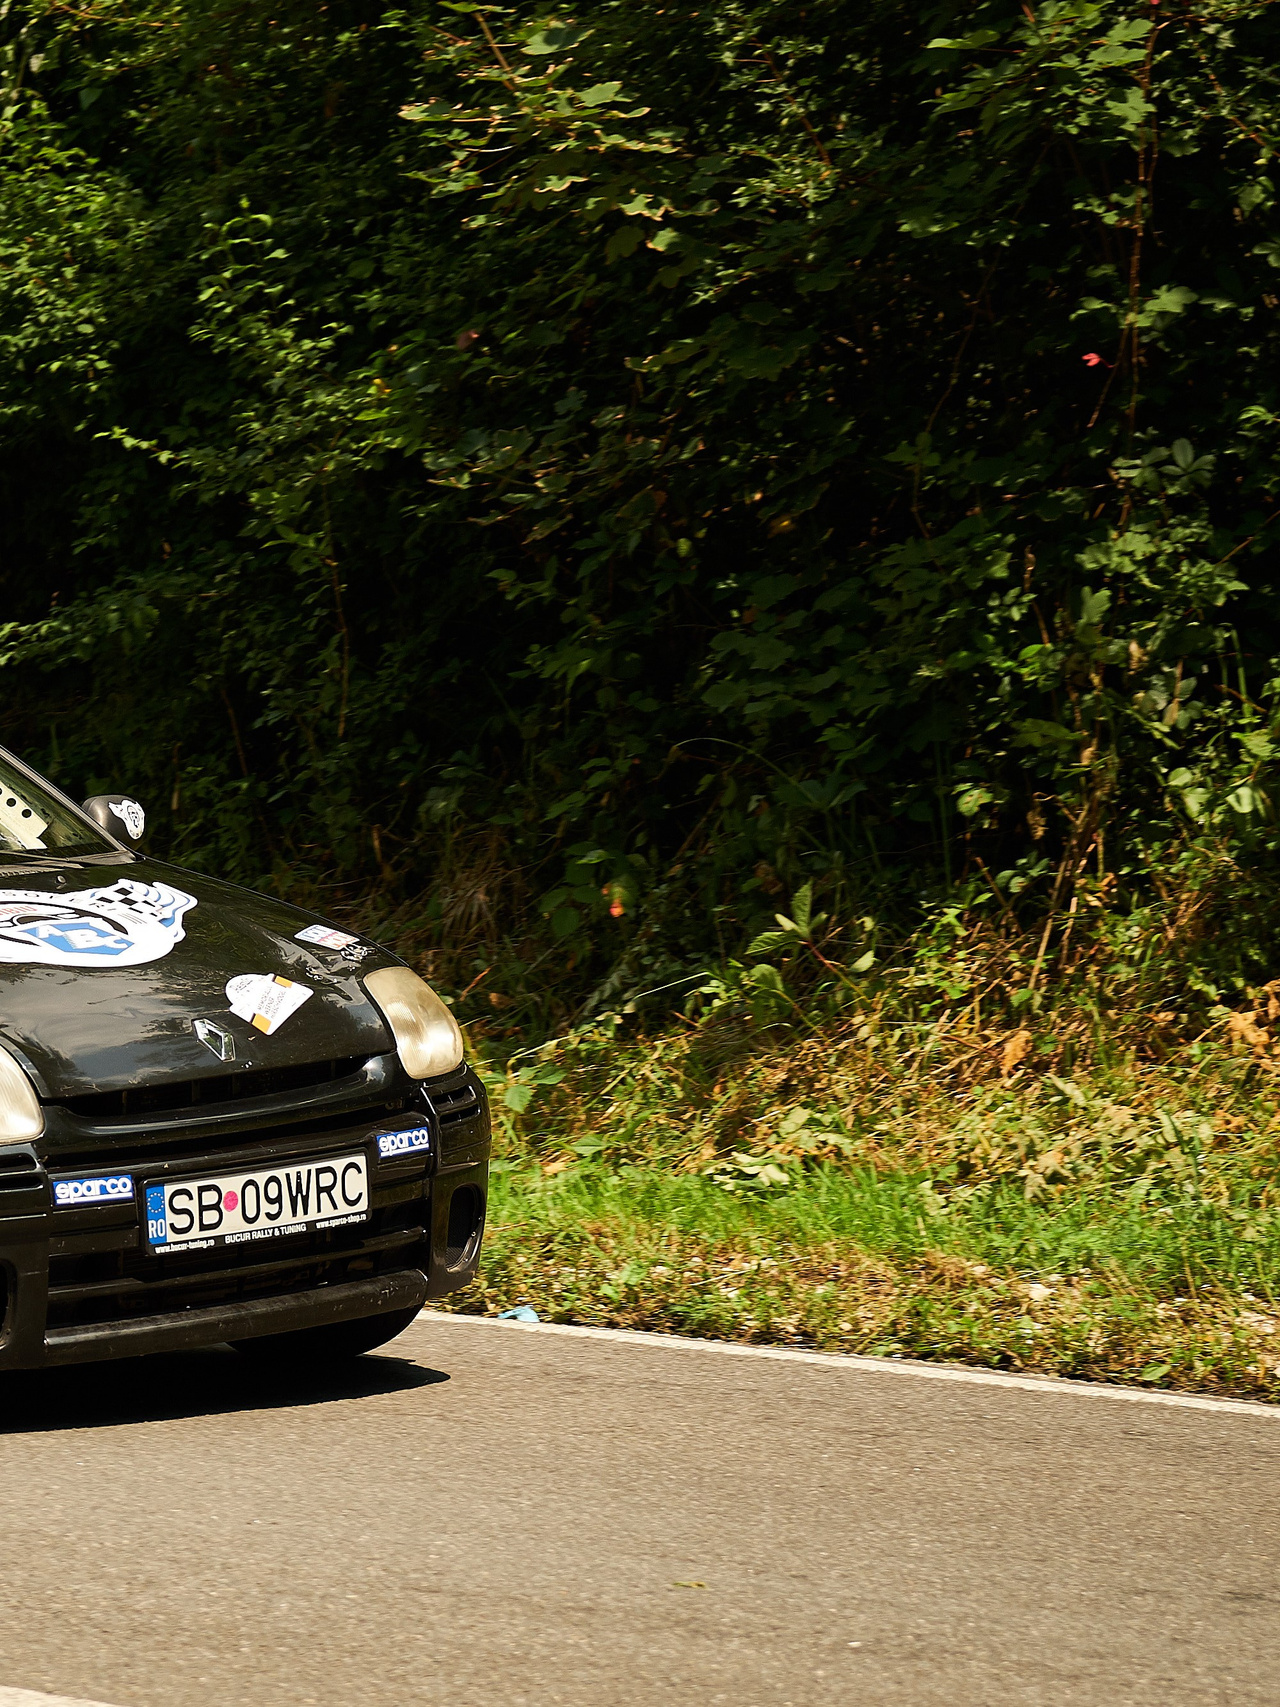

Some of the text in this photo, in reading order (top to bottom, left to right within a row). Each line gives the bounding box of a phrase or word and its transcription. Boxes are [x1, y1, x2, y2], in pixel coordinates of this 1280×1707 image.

[38, 923, 129, 950] ABC
[379, 1127, 429, 1153] sparco
[54, 1176, 132, 1202] sparco
[168, 1183, 224, 1235] SB
[148, 1218, 166, 1240] RO
[225, 1233, 251, 1244] BUCUR
[251, 1229, 273, 1240] RALLY
[274, 1227, 280, 1236] &
[280, 1223, 307, 1236] TUNING
